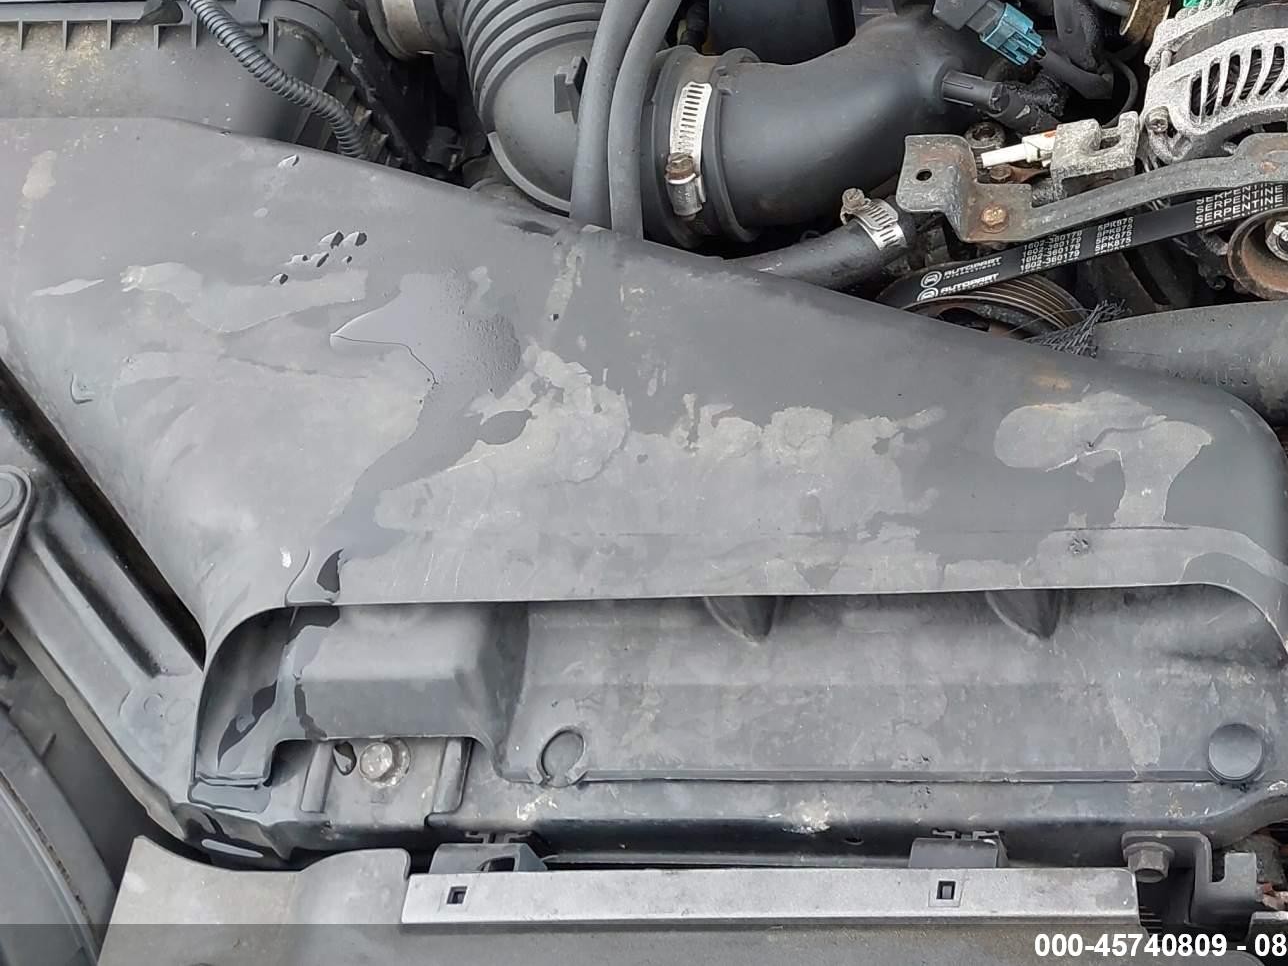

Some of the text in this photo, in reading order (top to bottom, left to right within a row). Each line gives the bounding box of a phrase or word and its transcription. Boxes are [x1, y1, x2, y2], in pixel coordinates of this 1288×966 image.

[1195, 193, 1284, 224] SERPENTINE
[1196, 184, 1283, 214] SERPENTINE
[1094, 237, 1132, 252] 5PK875
[944, 255, 1002, 278] AUTOPART
[940, 272, 1000, 294] AUTOPART
